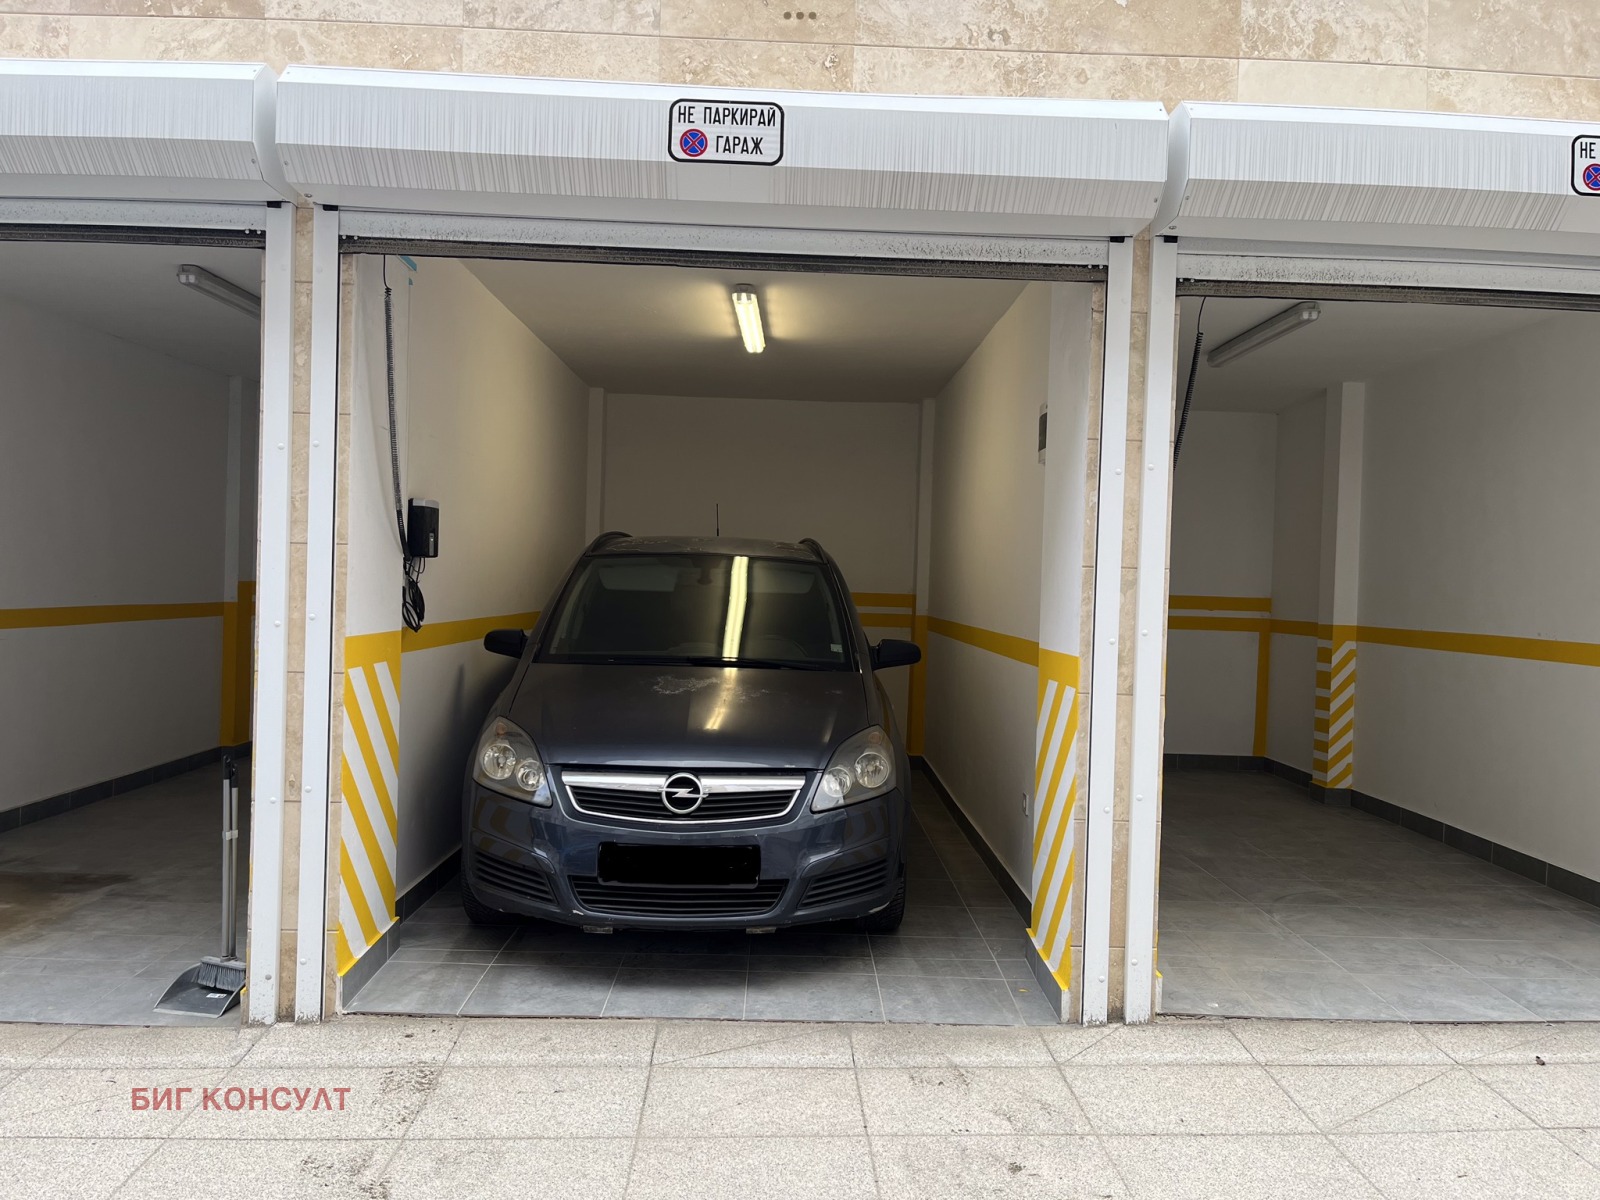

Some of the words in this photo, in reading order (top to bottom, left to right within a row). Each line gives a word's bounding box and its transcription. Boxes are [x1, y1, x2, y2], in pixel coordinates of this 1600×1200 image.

[678, 105, 695, 123] НЕ
[703, 106, 776, 127] ПАРКИРАЙ
[715, 135, 763, 155] ГАРАЖ
[1580, 141, 1596, 159] НЕ
